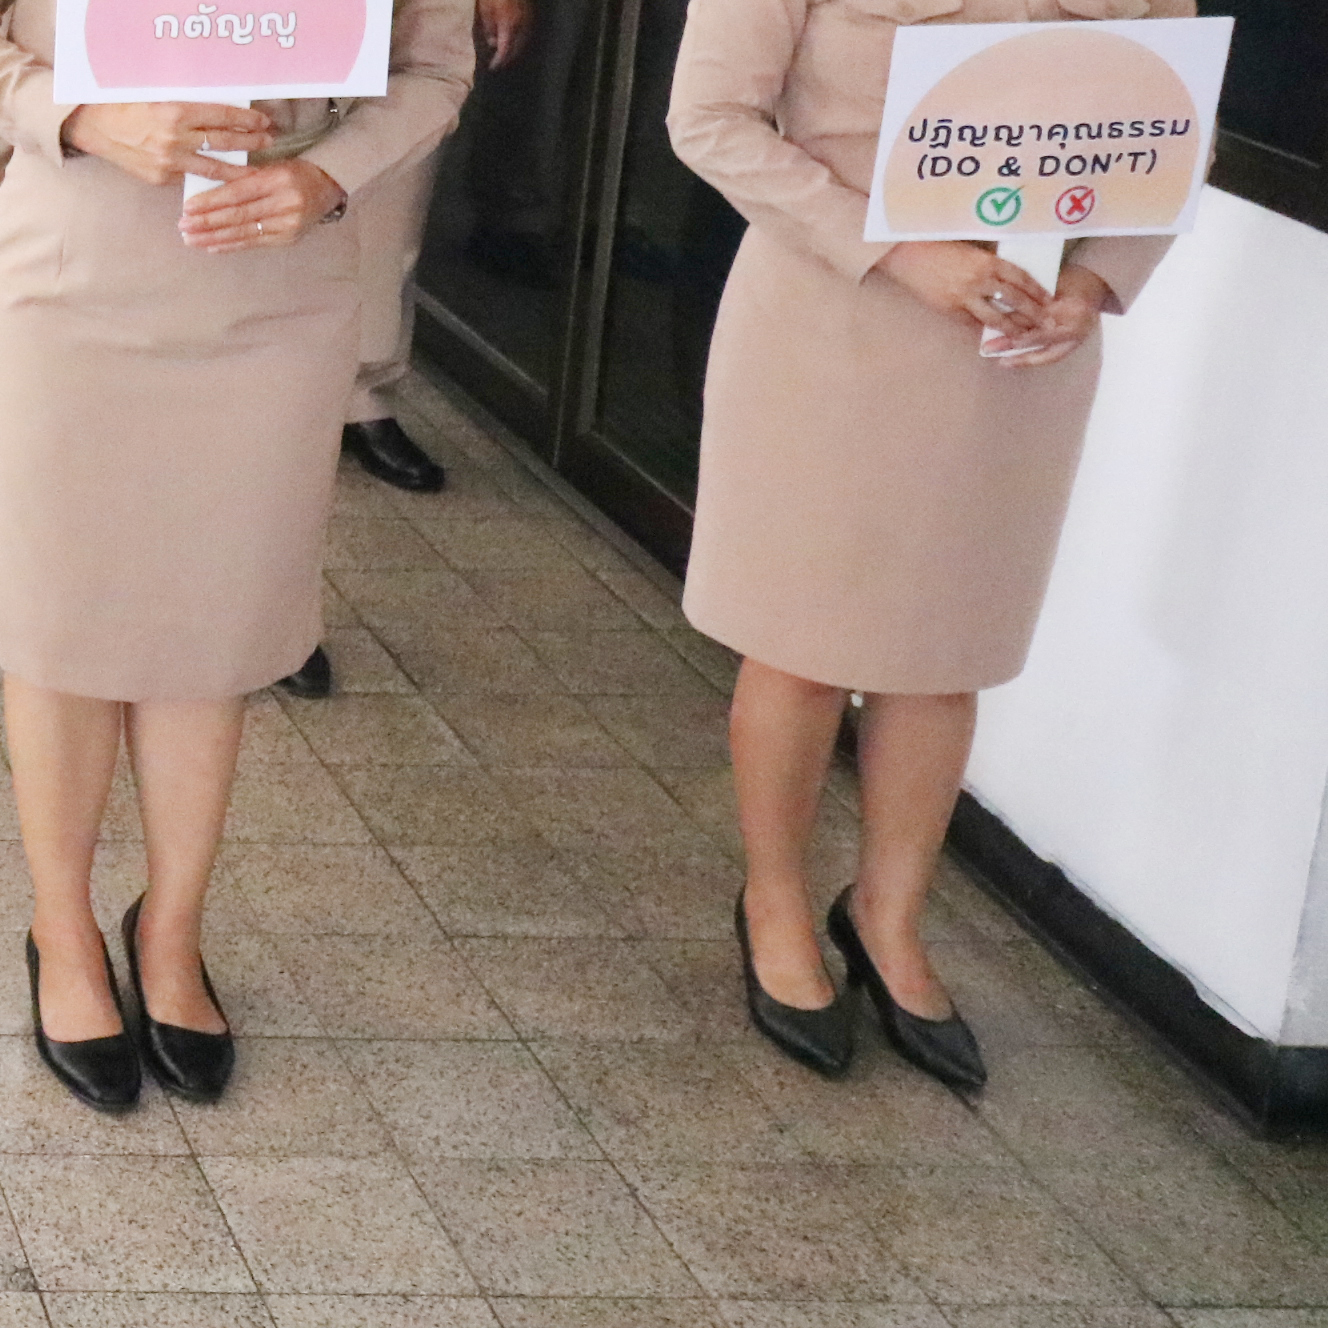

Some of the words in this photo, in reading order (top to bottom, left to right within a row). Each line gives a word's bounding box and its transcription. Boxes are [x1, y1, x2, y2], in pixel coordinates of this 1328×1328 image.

[152, 2, 298, 49] กตัญญู
[907, 116, 1192, 150] ปฏิญญาคุณธรรม
[916, 153, 981, 180] (DO
[997, 155, 1022, 178] &
[1038, 148, 1158, 178] DON'T)
